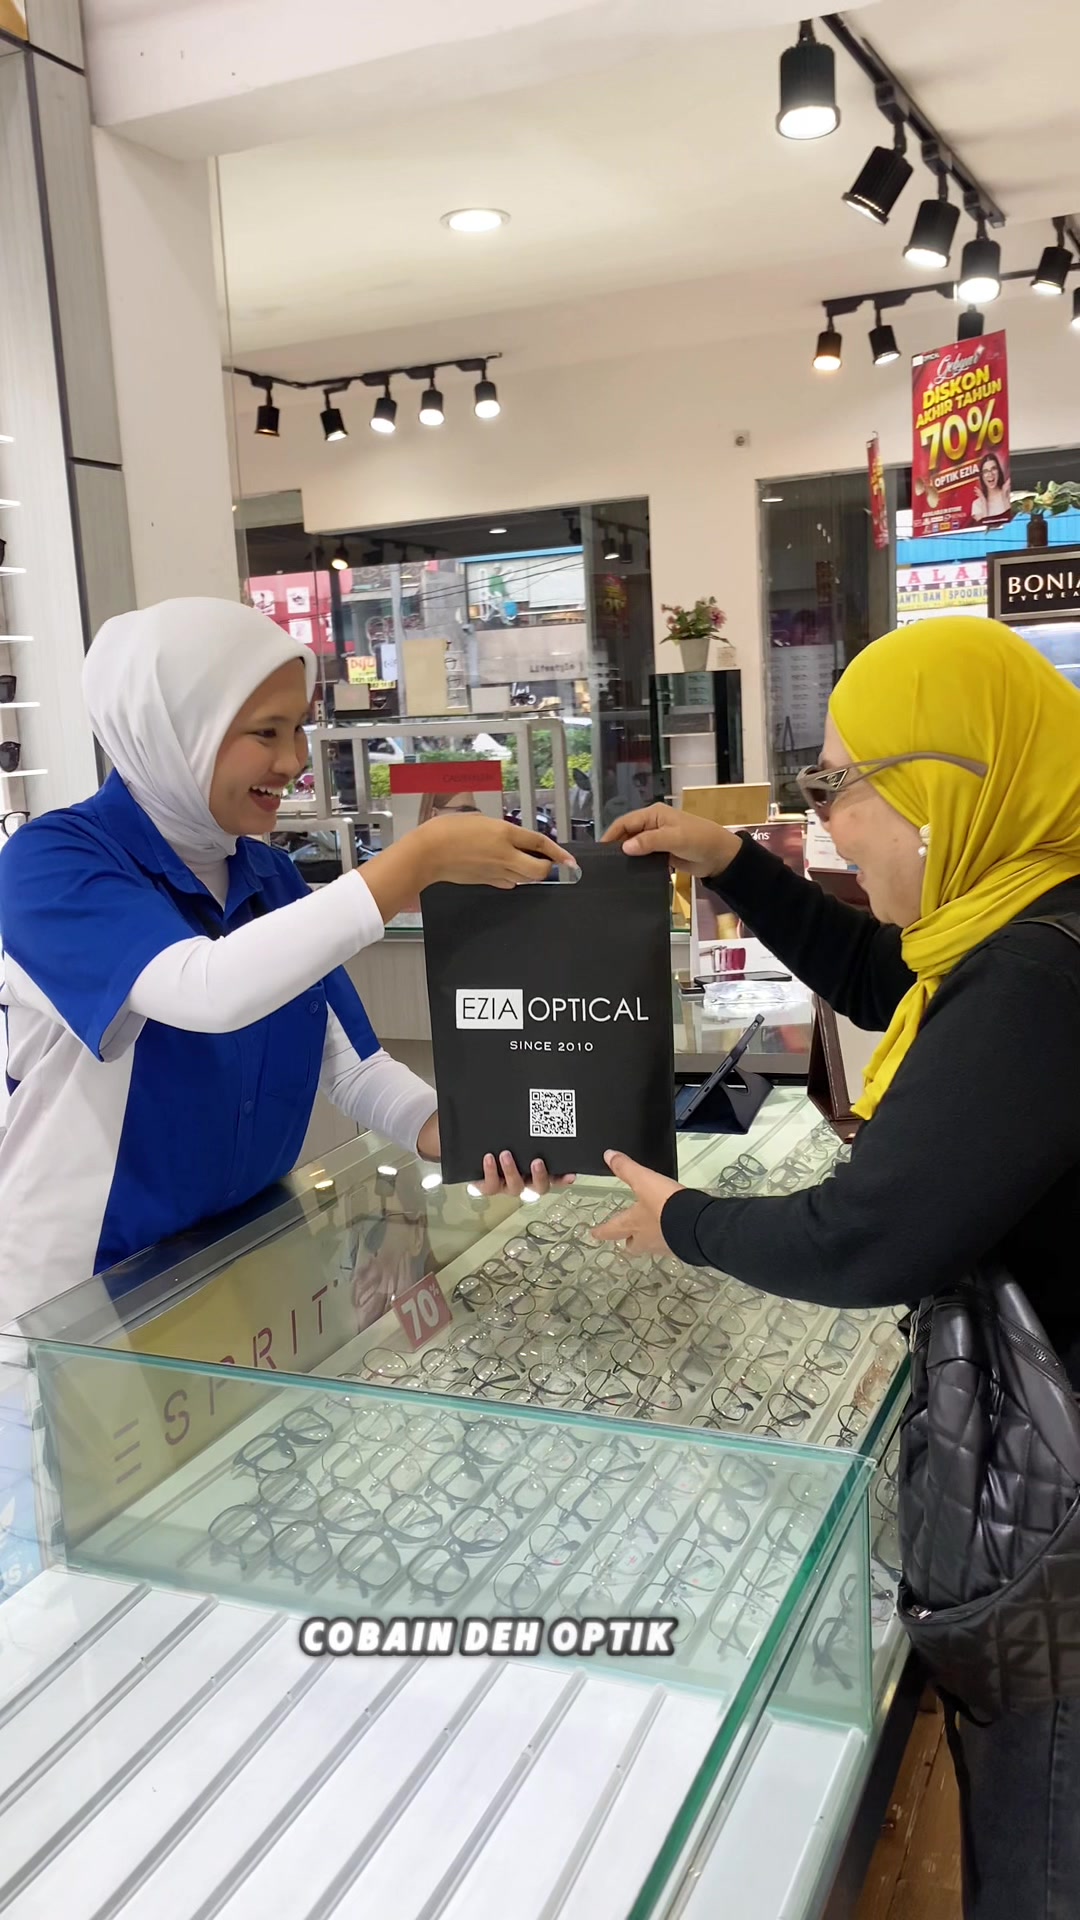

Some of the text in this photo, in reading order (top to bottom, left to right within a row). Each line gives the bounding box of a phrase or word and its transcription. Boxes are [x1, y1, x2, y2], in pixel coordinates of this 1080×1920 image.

[915, 377, 1003, 430] AKHIR TAHUN
[923, 364, 990, 410] DISKON
[920, 398, 1005, 471] 70%
[934, 463, 981, 488] OPTIK EZIA
[463, 996, 650, 1022] EZIA OPTICAL
[509, 1040, 594, 1052] SINCE 2010
[401, 1283, 440, 1340] 70%
[113, 1285, 329, 1484] ESPRIT
